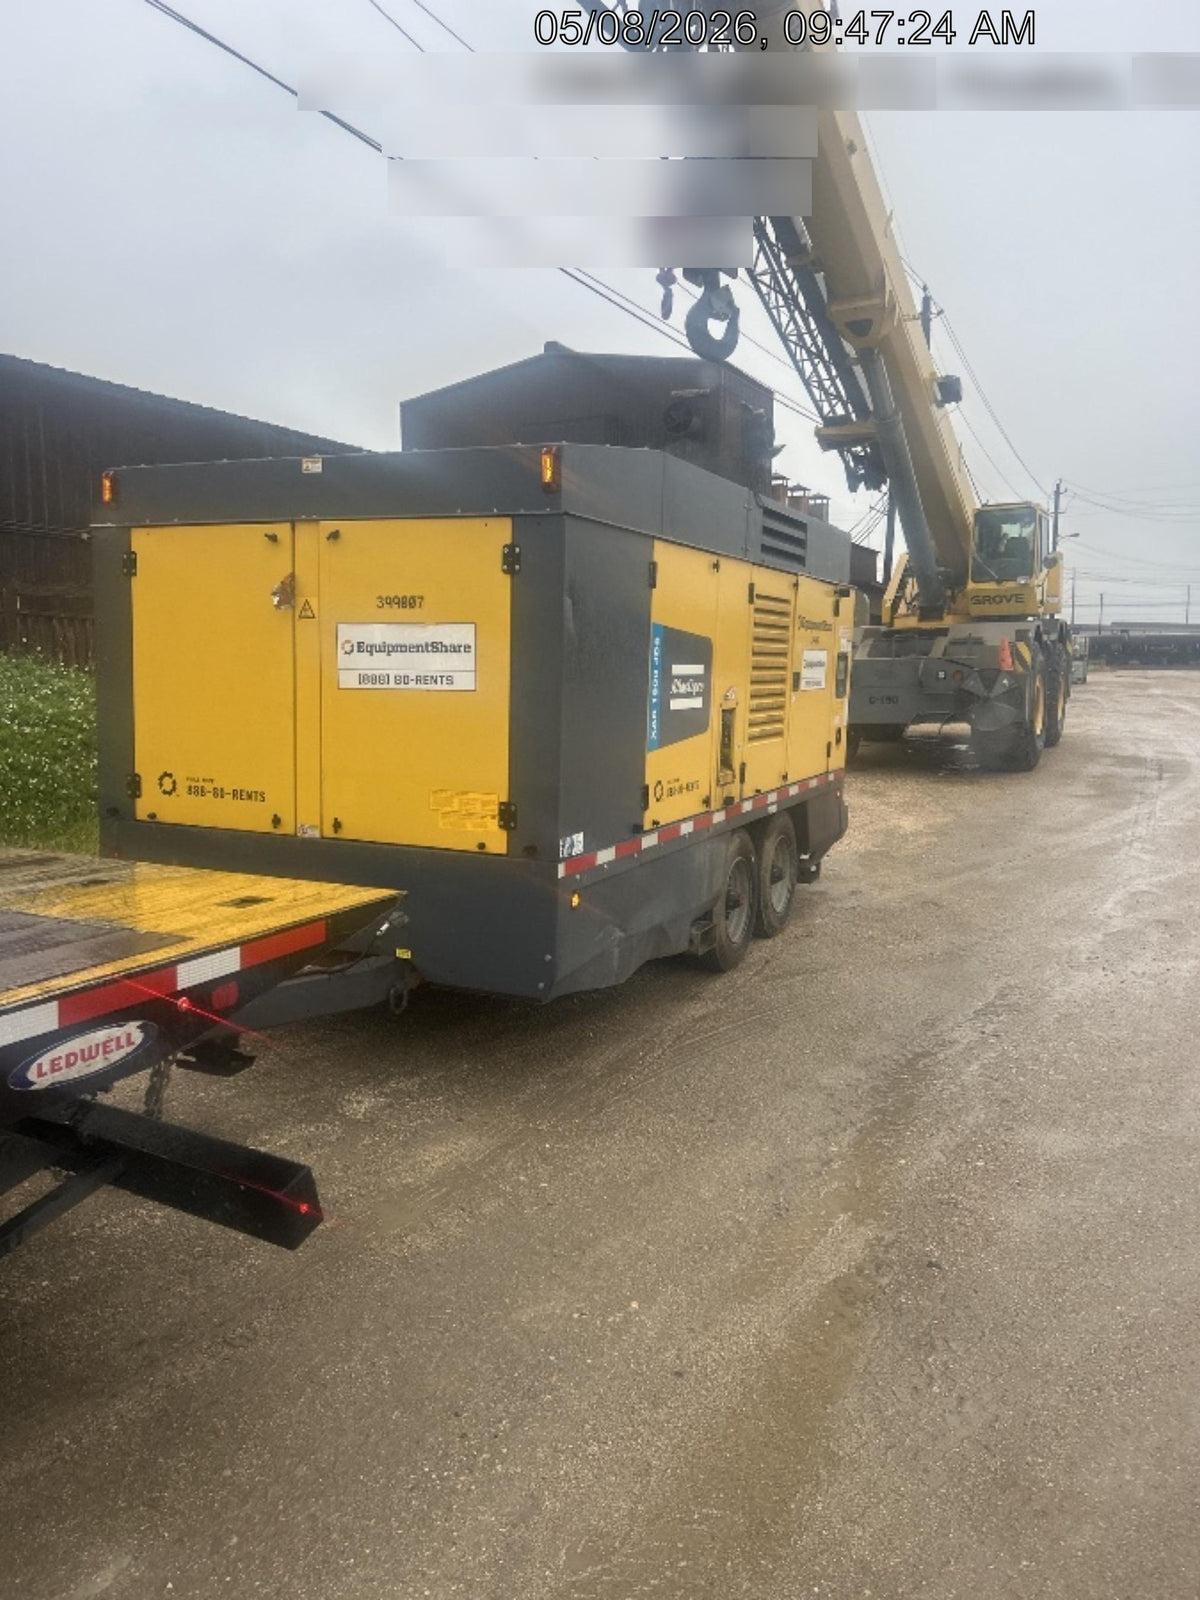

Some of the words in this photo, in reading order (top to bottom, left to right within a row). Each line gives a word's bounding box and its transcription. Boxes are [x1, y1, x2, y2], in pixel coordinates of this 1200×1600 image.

[970, 593, 1025, 605] GROVE
[356, 641, 472, 656] EquipmentShare
[394, 675, 454, 686] 80-RENTS
[36, 1032, 136, 1078] LEDWELL
